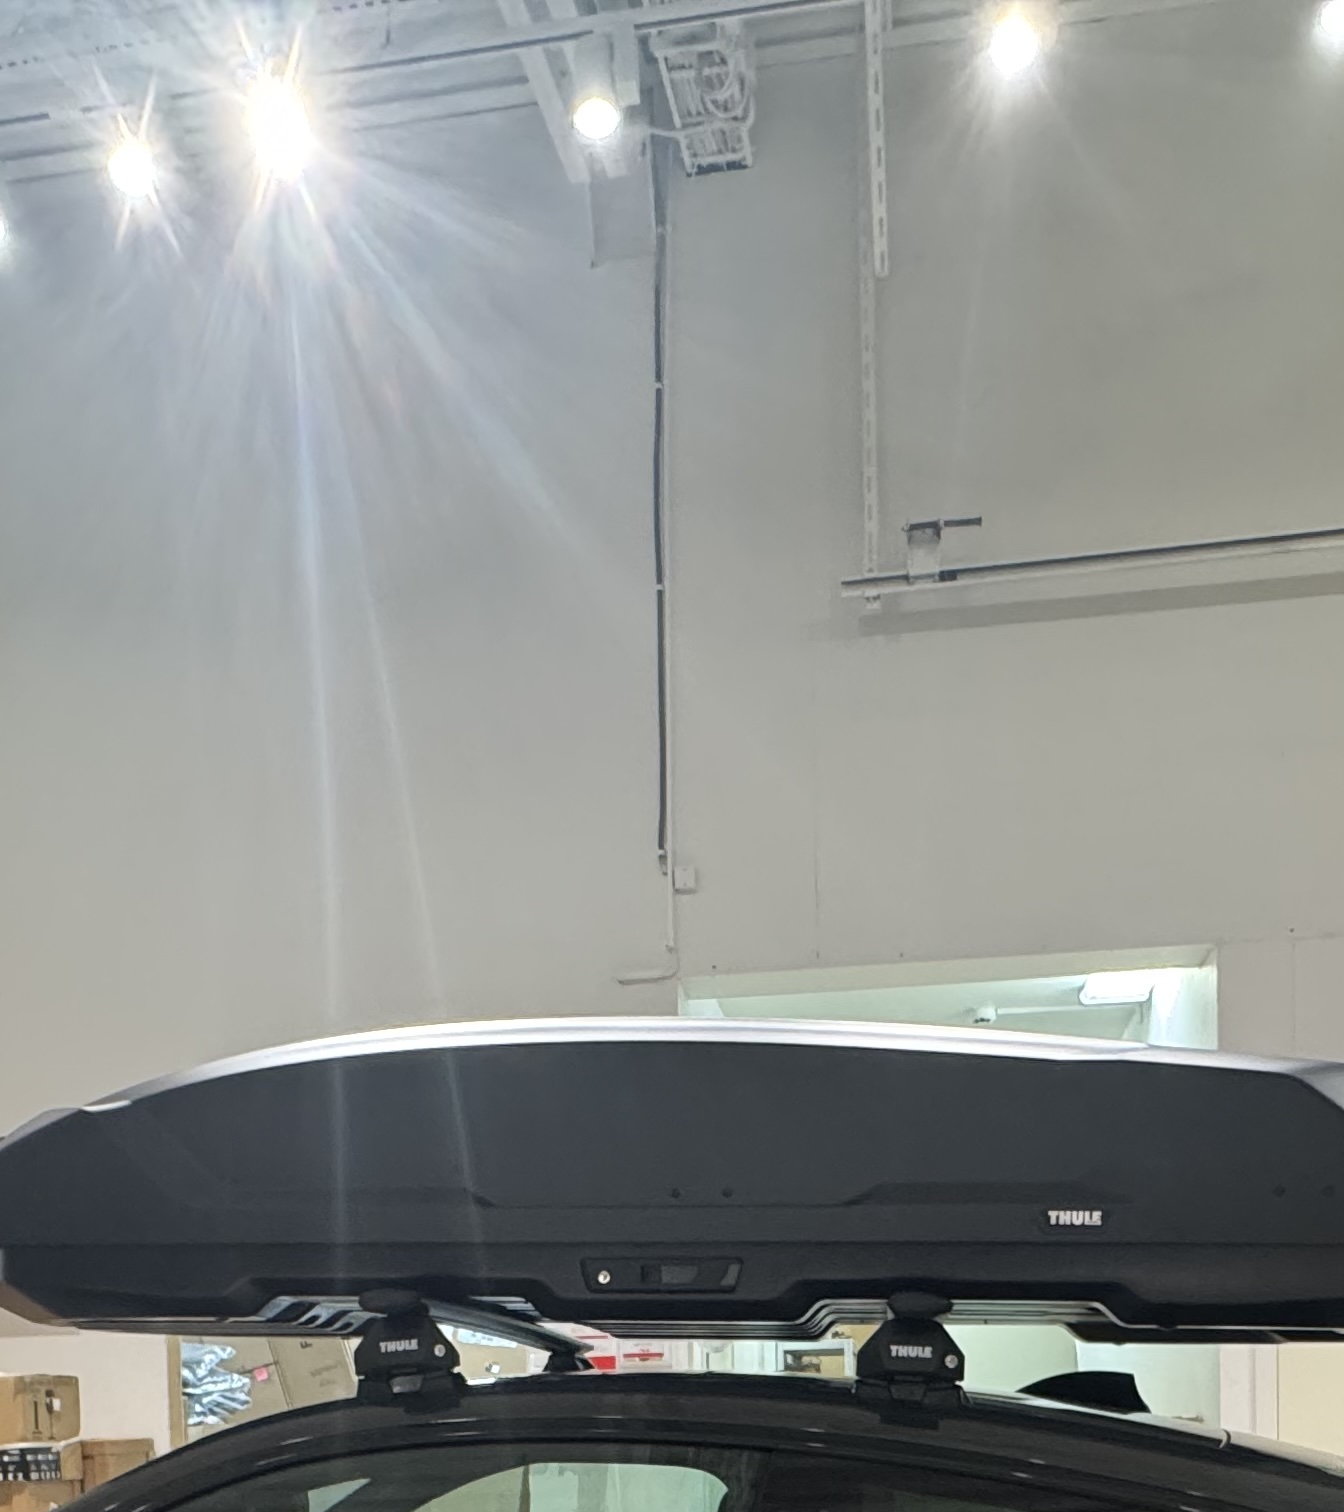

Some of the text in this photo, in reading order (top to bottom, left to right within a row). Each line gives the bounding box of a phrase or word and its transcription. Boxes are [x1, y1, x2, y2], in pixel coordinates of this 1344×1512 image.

[1047, 1210, 1103, 1226] THULE
[379, 1338, 419, 1353] THULE
[889, 1344, 933, 1358] THULE
